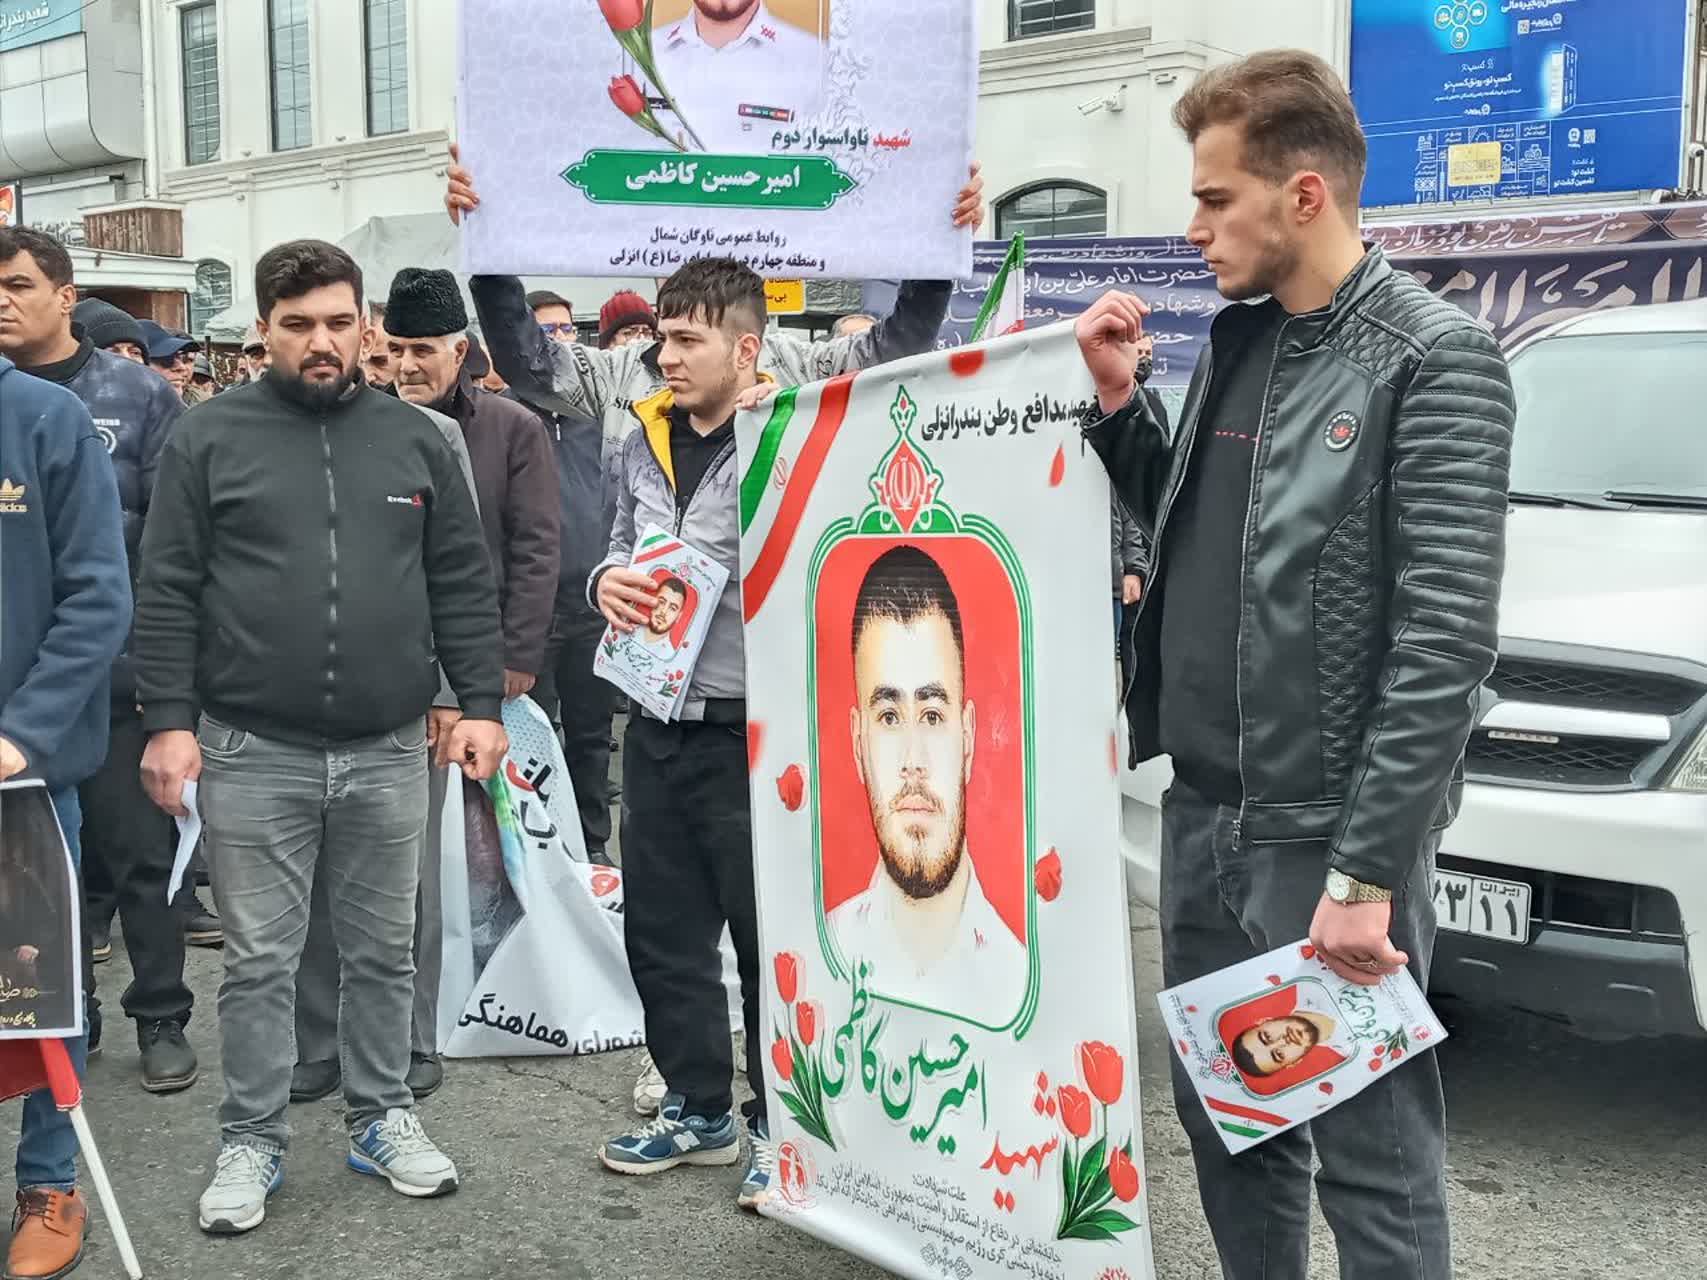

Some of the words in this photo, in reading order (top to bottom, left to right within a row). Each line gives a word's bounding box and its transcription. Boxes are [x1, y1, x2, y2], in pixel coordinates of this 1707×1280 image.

[771, 128, 801, 149] دوم
[873, 128, 912, 150] شهید
[625, 160, 699, 190] کاظمی
[701, 169, 761, 192] حسین
[761, 164, 800, 195] امیر
[650, 226, 678, 245] شمال
[680, 228, 715, 246] ناوگان
[716, 231, 753, 248] عمومی
[755, 228, 787, 248] روابط
[609, 249, 640, 266] انزلی
[642, 249, 665, 270] (ع)
[751, 254, 783, 271] چهارم
[785, 252, 817, 270] منطقه
[817, 258, 826, 272] و
[1093, 266, 1139, 289] امام
[1138, 266, 1217, 289] حضرت
[983, 397, 1018, 437] وطن
[1022, 391, 1067, 435] مدافع
[1480, 882, 1520, 898] ایران
[458, 993, 568, 1048] هماهنگی
[820, 956, 887, 1099] کاظمی
[880, 1032, 970, 1121] حسین
[909, 1057, 988, 1154] امیر
[980, 1069, 1060, 1214] شهید
[947, 1204, 980, 1230] استقلال
[990, 1222, 1009, 1242] دفاع
